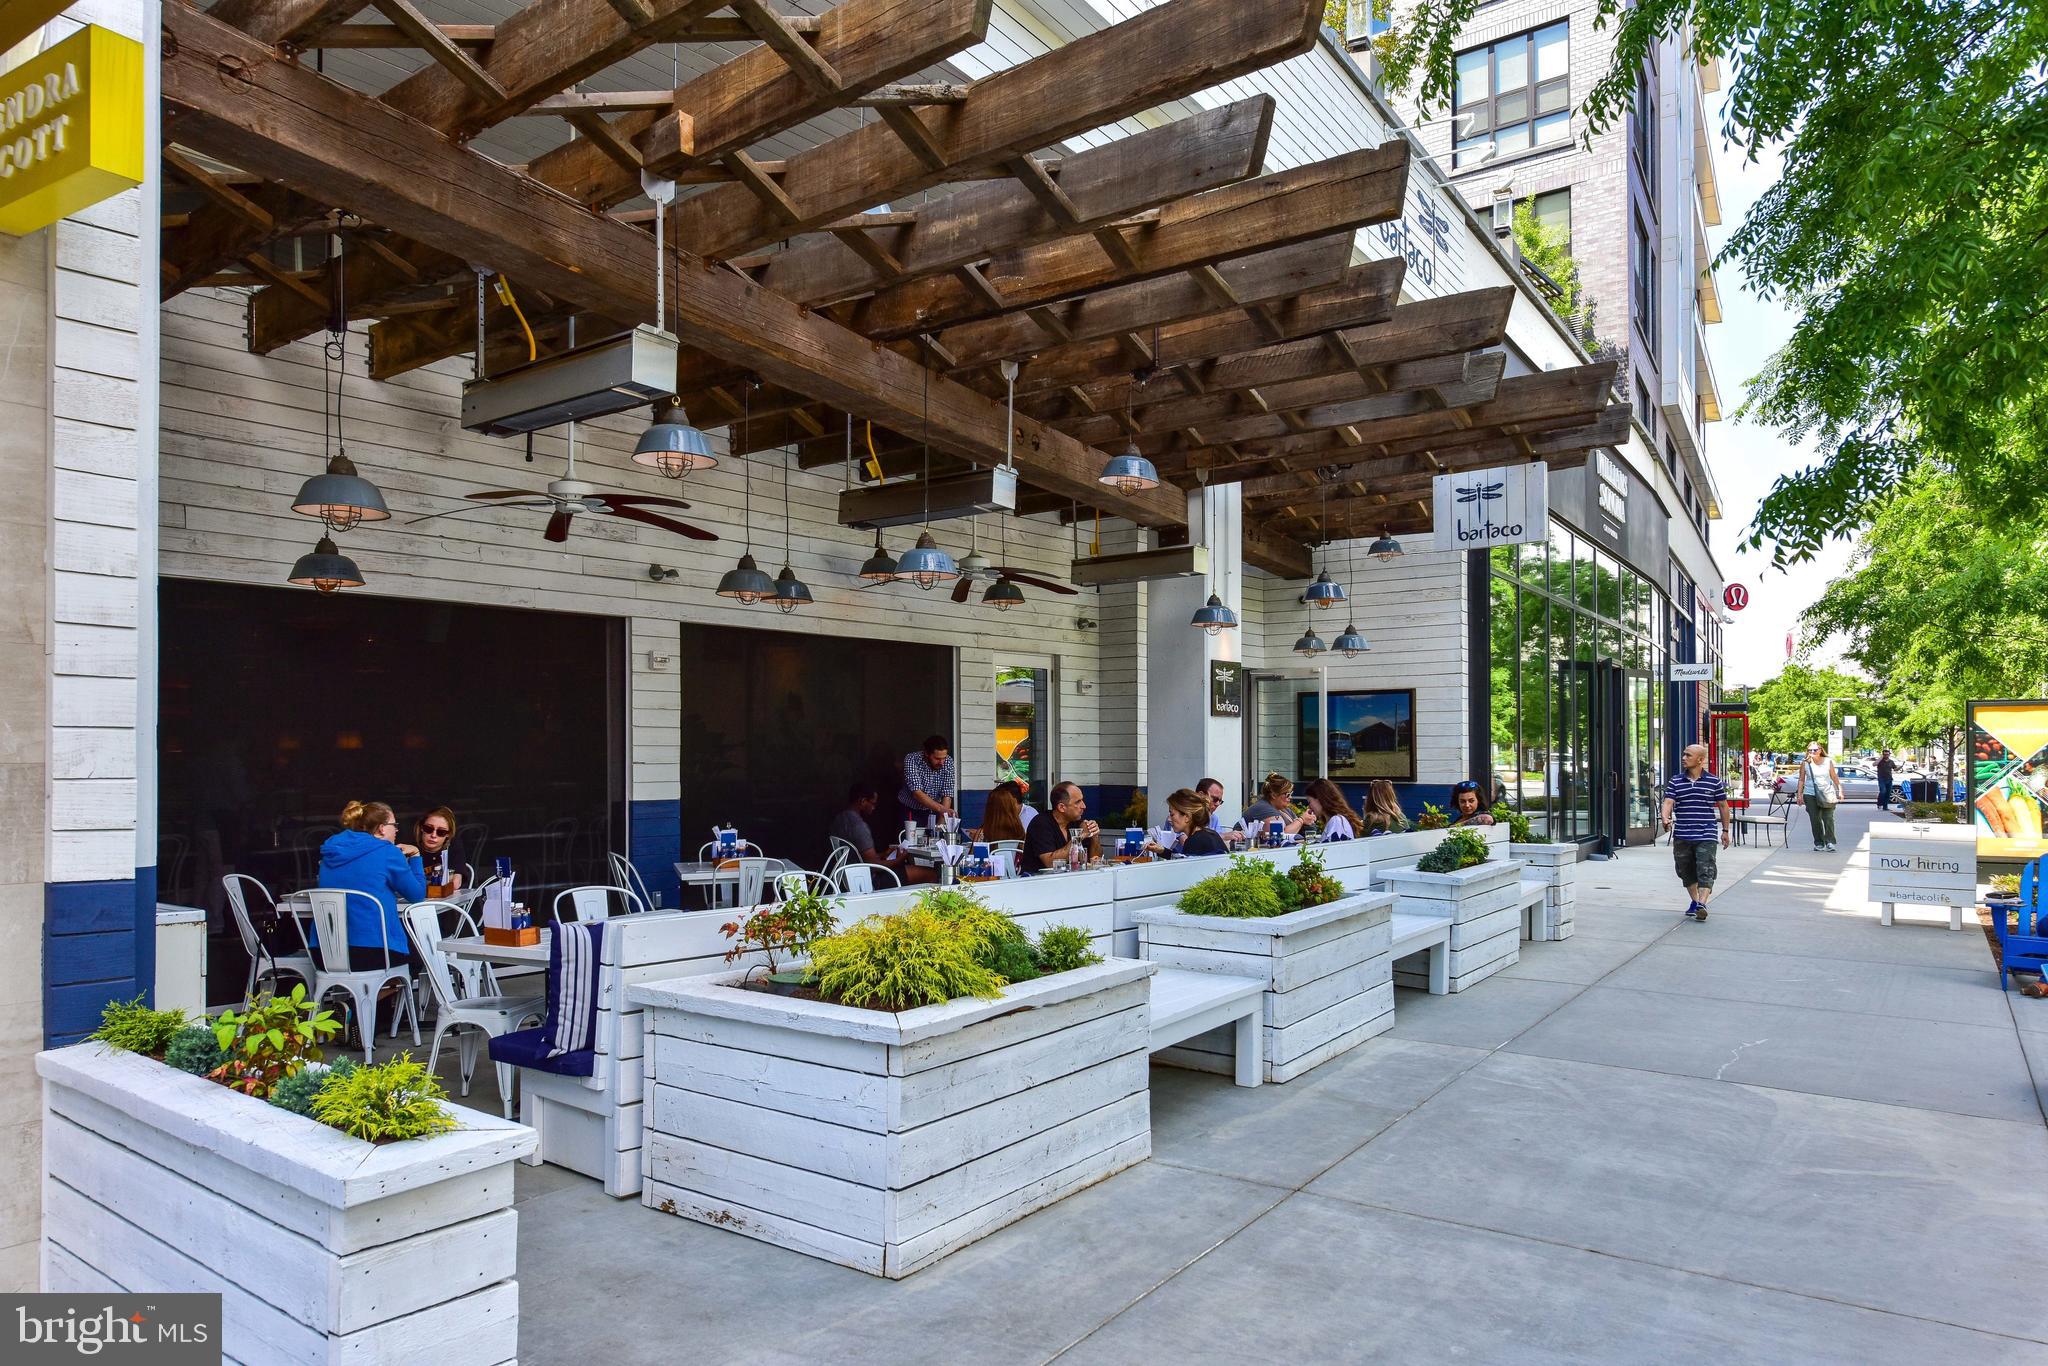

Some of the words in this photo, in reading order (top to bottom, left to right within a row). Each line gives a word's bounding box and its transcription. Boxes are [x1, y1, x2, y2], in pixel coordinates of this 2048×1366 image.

[1457, 519, 1523, 541] bartaco
[1215, 694, 1239, 713] bartaco
[1880, 857, 1910, 869] now
[1917, 857, 1960, 873] hiring
[1889, 890, 1951, 903] #bartacolife
